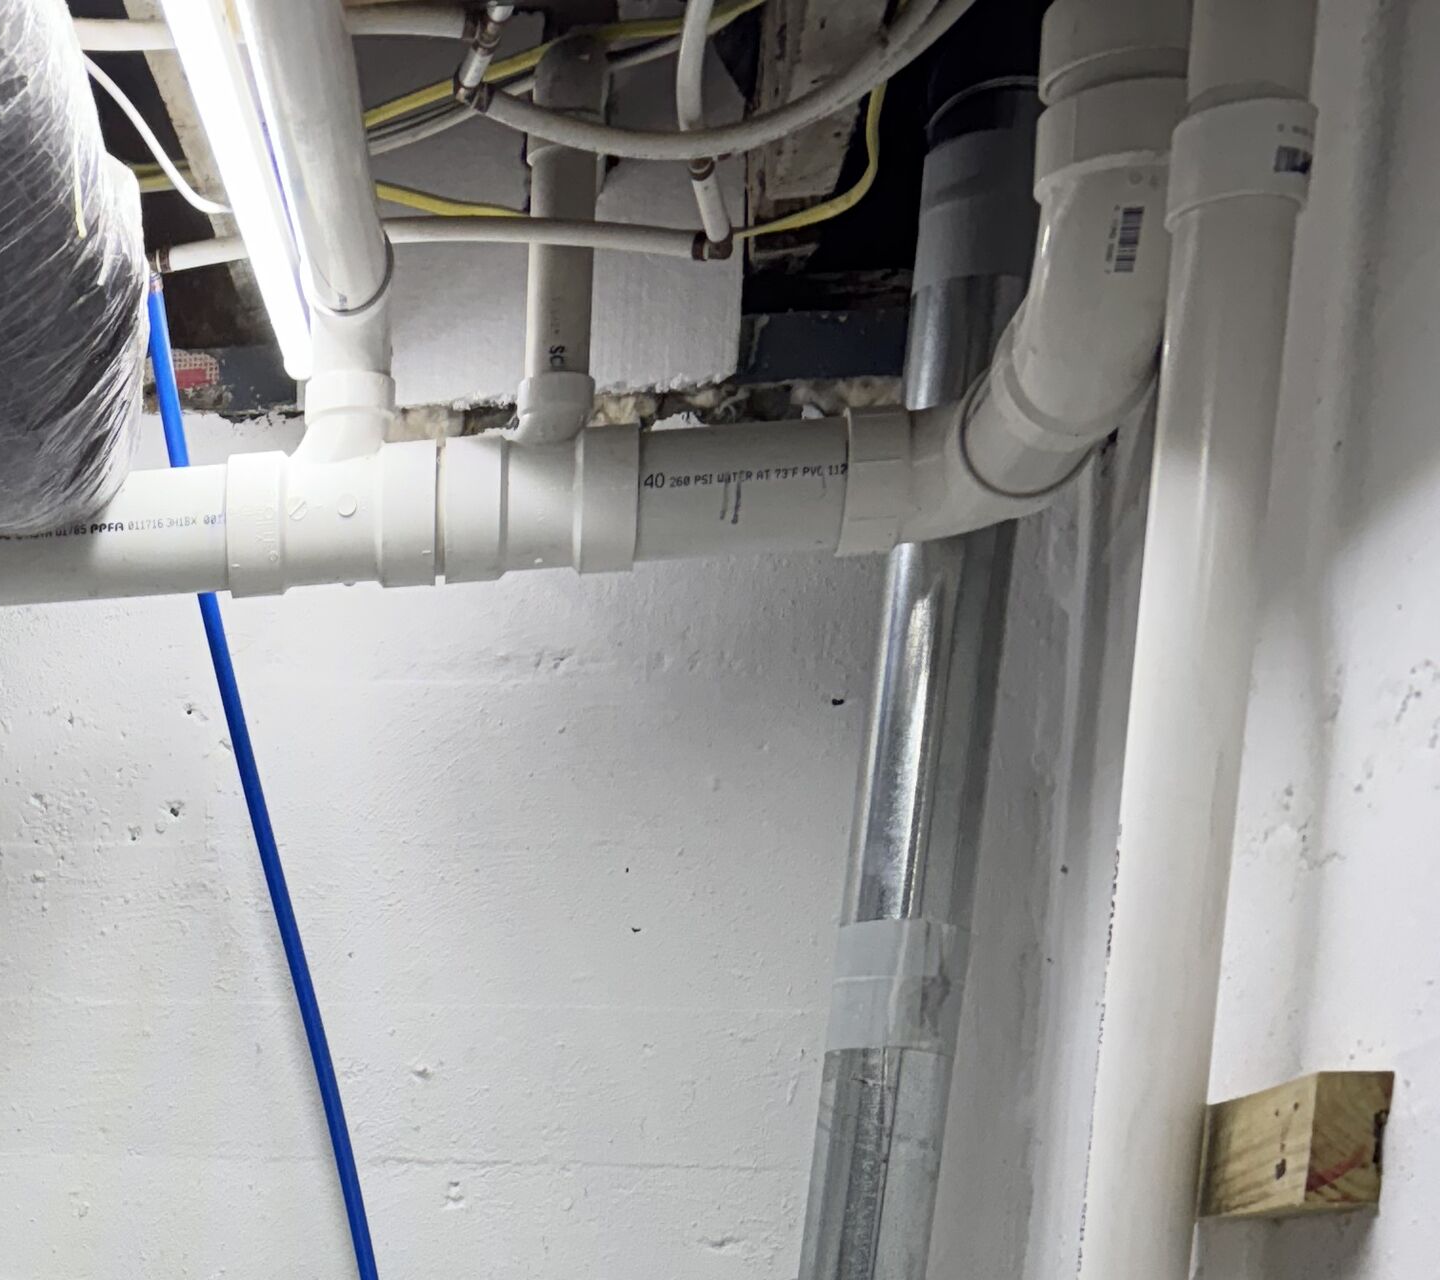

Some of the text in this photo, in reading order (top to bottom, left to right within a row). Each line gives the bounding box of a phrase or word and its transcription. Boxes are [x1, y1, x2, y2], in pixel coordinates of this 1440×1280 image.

[643, 472, 665, 489] 40
[669, 476, 691, 488] 260
[693, 473, 713, 485] PSI
[717, 471, 753, 484] WATER
[756, 469, 771, 480] AT
[802, 465, 824, 477] PVC
[90, 522, 124, 534] PPFA
